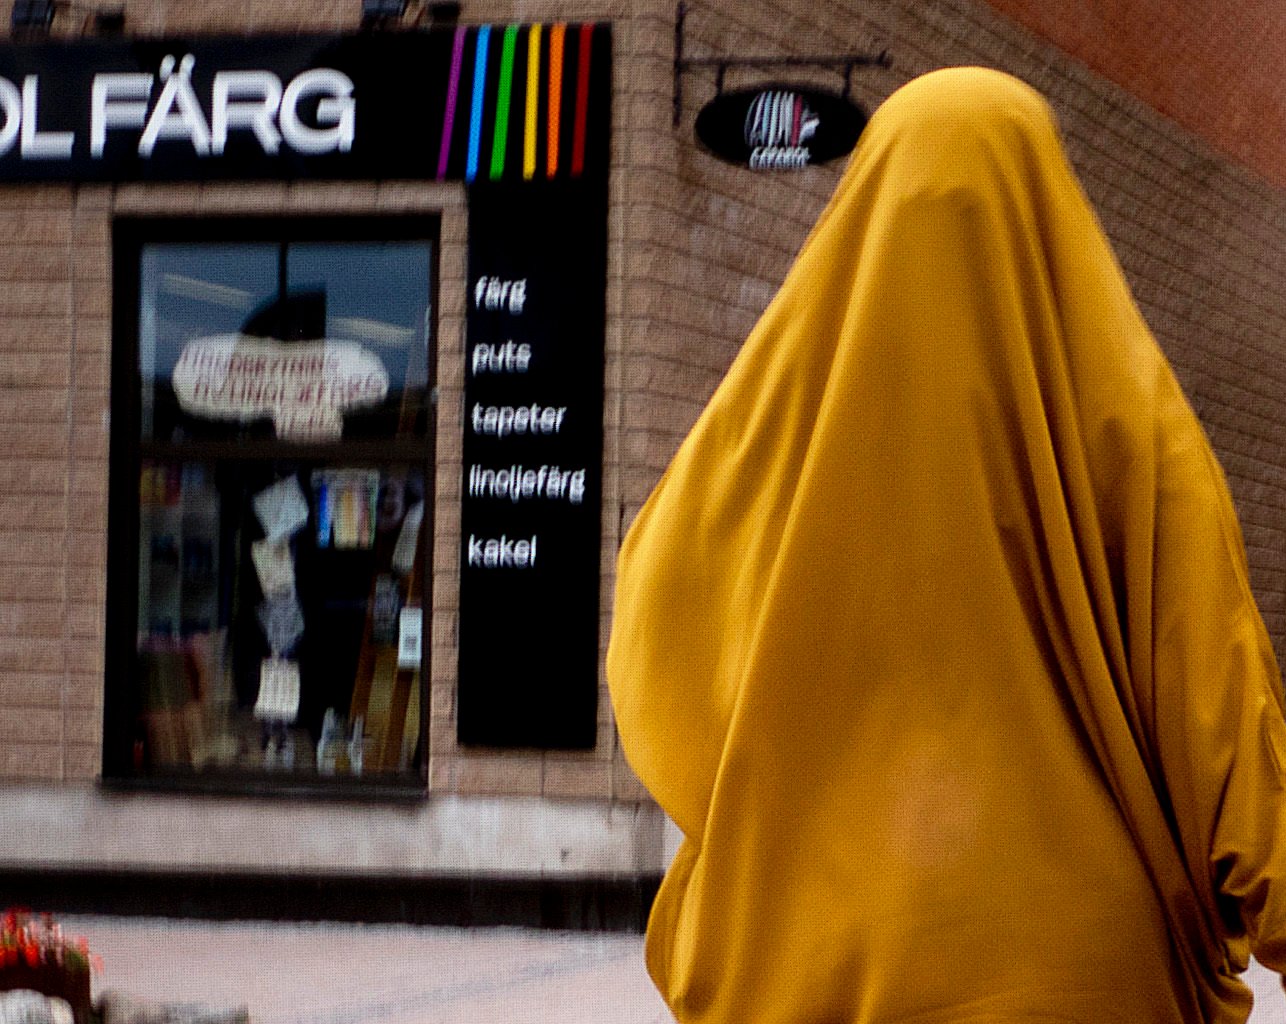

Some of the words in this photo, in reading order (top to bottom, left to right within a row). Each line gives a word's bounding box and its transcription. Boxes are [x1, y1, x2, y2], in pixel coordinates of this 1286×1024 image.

[90, 53, 356, 160] FÄRG
[475, 275, 527, 315] färg
[472, 340, 531, 377] puts
[472, 402, 568, 440] tapeter
[469, 464, 586, 505] linoljefärg
[468, 533, 537, 568] kakel
